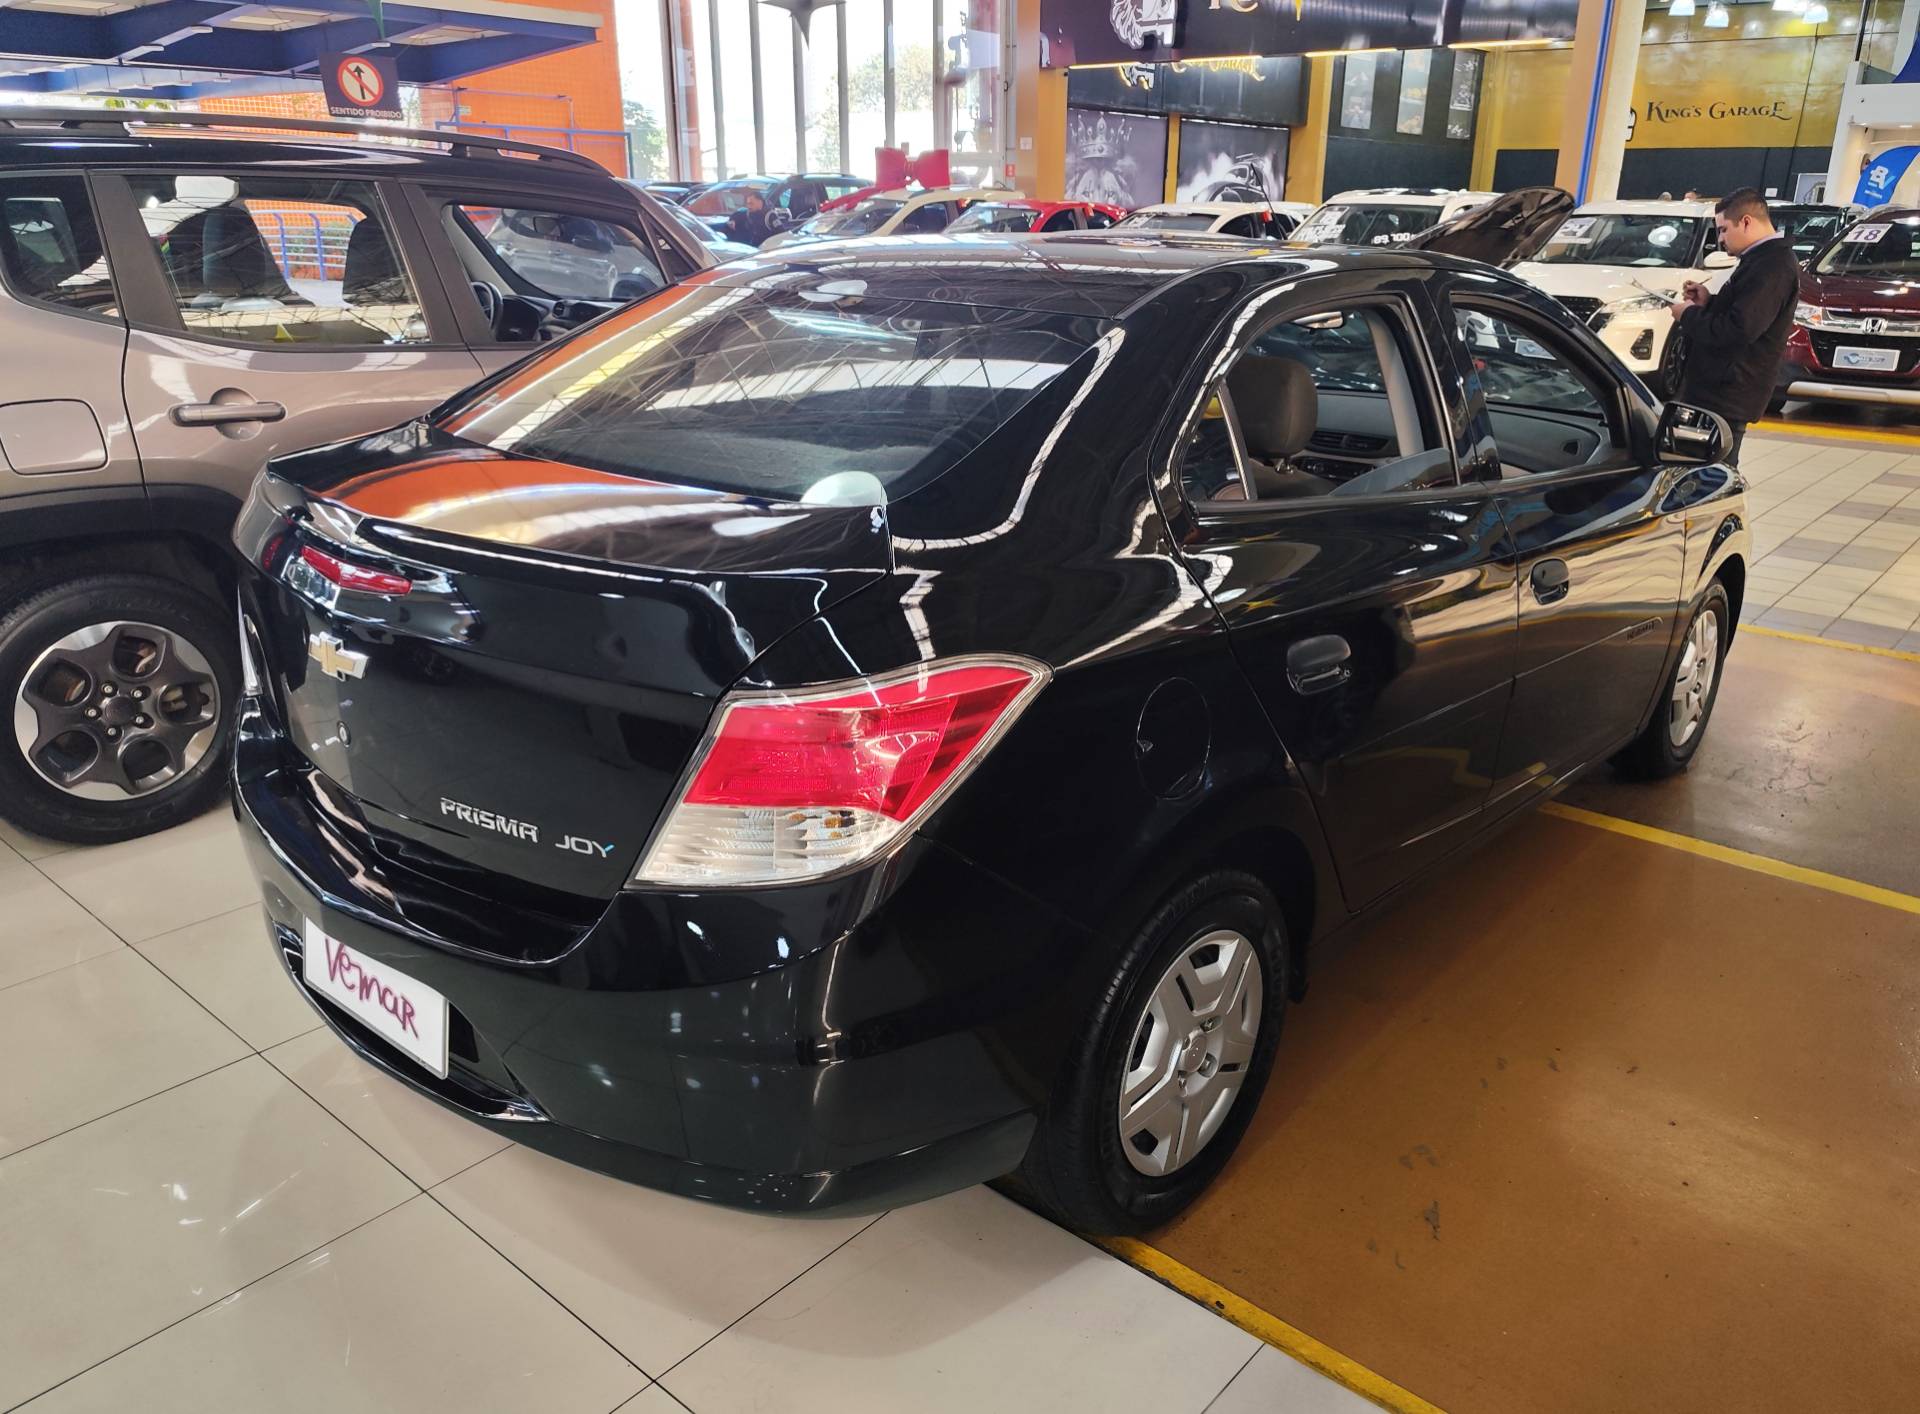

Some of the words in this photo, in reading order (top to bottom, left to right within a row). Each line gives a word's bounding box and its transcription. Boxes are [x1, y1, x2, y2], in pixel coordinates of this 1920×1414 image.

[330, 106, 365, 116] SENTIDO
[365, 109, 402, 119] PROIBIDO
[1853, 229, 1882, 241] 18
[440, 797, 539, 844] PRISMA
[555, 835, 615, 858] JOY
